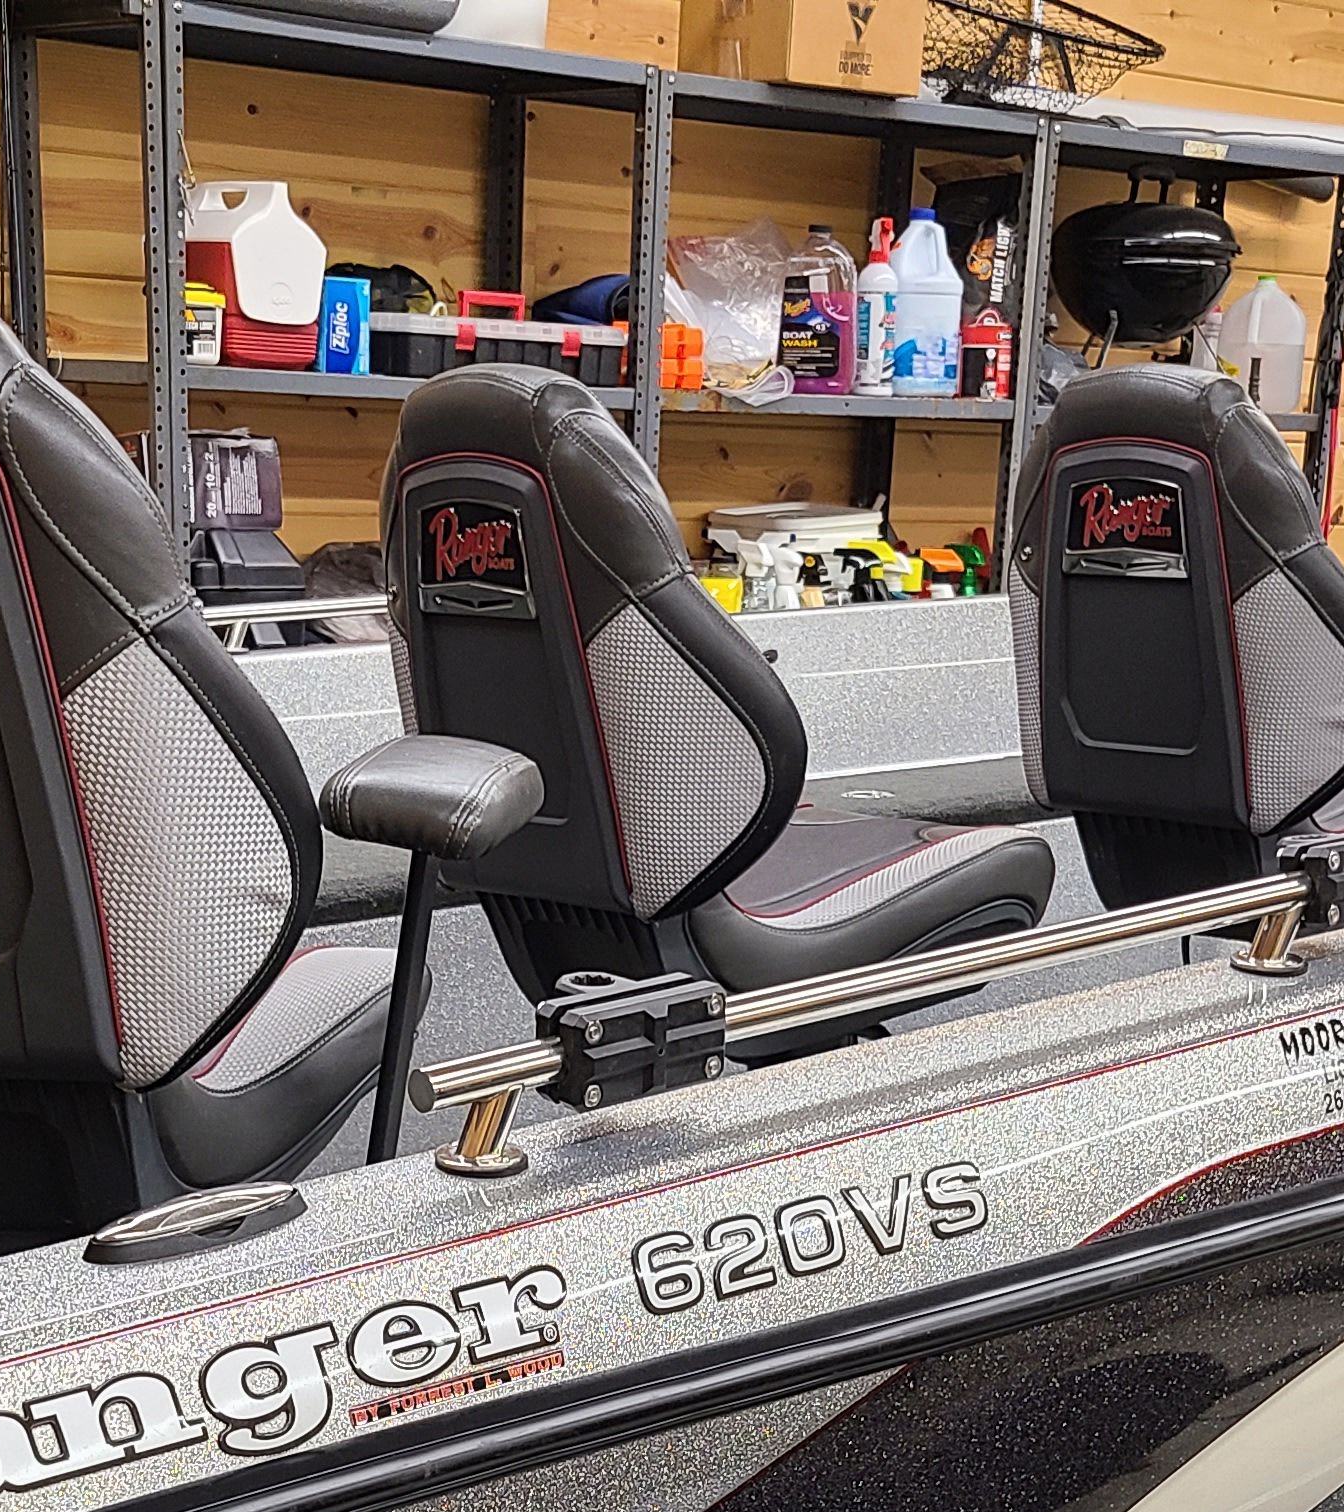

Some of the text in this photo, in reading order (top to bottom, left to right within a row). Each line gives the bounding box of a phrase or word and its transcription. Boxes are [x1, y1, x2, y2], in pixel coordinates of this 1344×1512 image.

[839, 61, 849, 74] DO
[990, 256, 1005, 303] MATCH
[332, 301, 349, 350] Ziploc
[783, 331, 813, 339] BOAT
[206, 473, 216, 489] 10
[206, 502, 216, 518] 20
[1080, 482, 1175, 547] Ranger
[428, 507, 512, 582] Ranger
[631, 1160, 988, 1315] 620VS
[354, 1406, 379, 1426] BY
[389, 1375, 474, 1415] FORREST
[507, 1352, 562, 1380] WOOD
